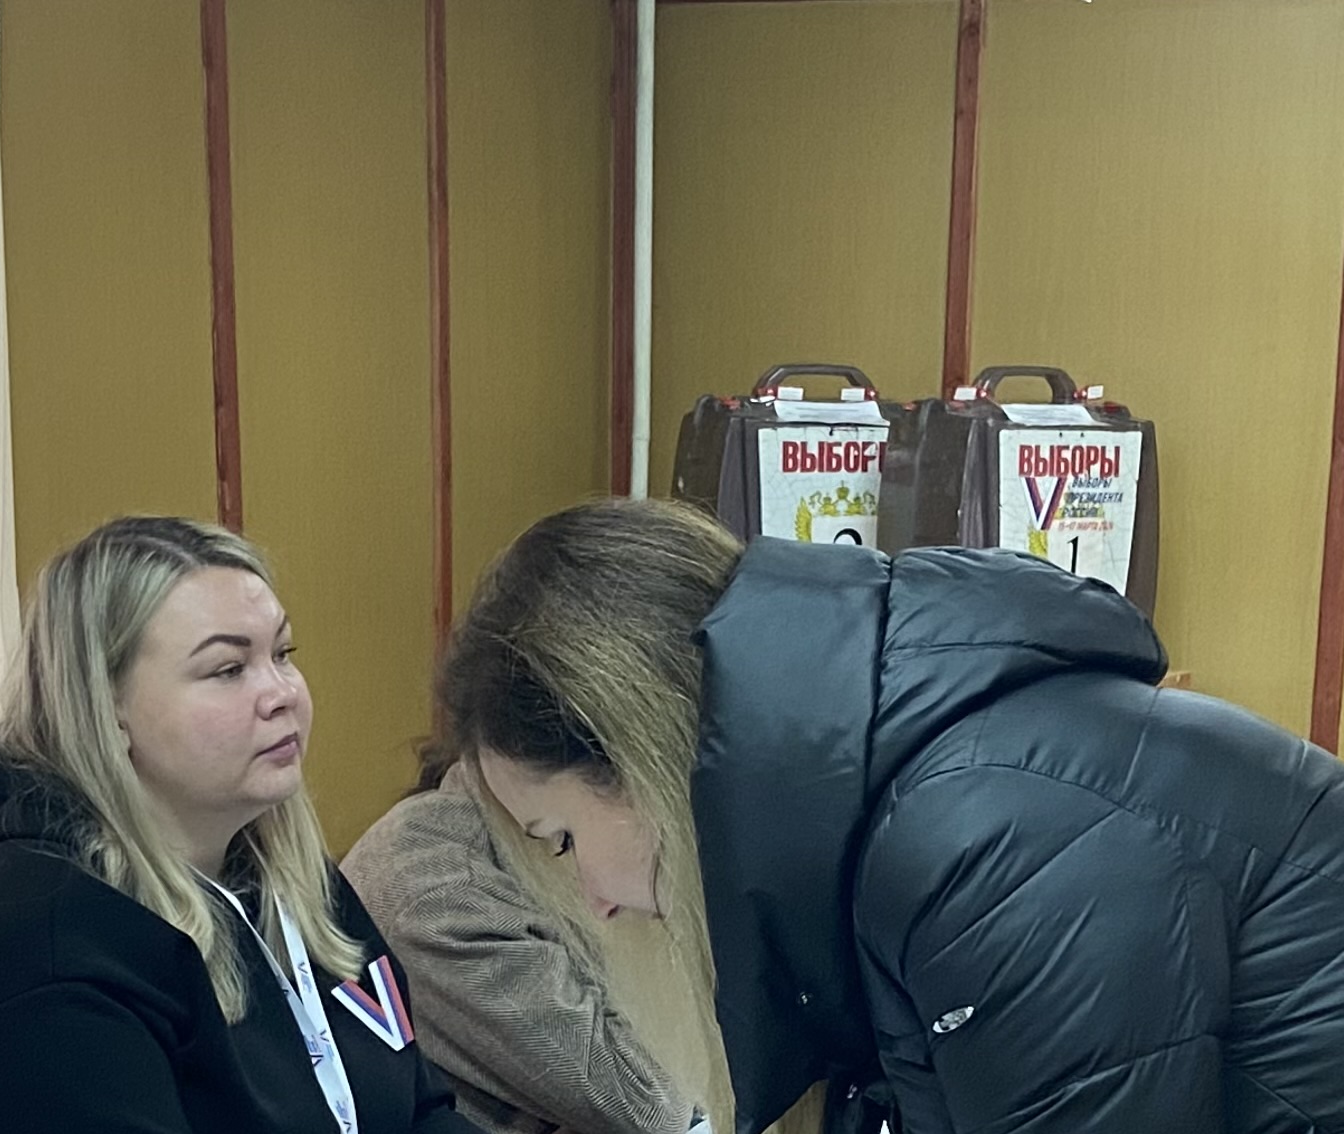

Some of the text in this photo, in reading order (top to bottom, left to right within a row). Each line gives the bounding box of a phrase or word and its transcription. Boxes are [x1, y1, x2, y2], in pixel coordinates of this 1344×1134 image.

[1019, 445, 1121, 478] ВЫБОРЫ
[1072, 477, 1112, 489] ВЫБОРЫ
[1067, 536, 1079, 574] 1
